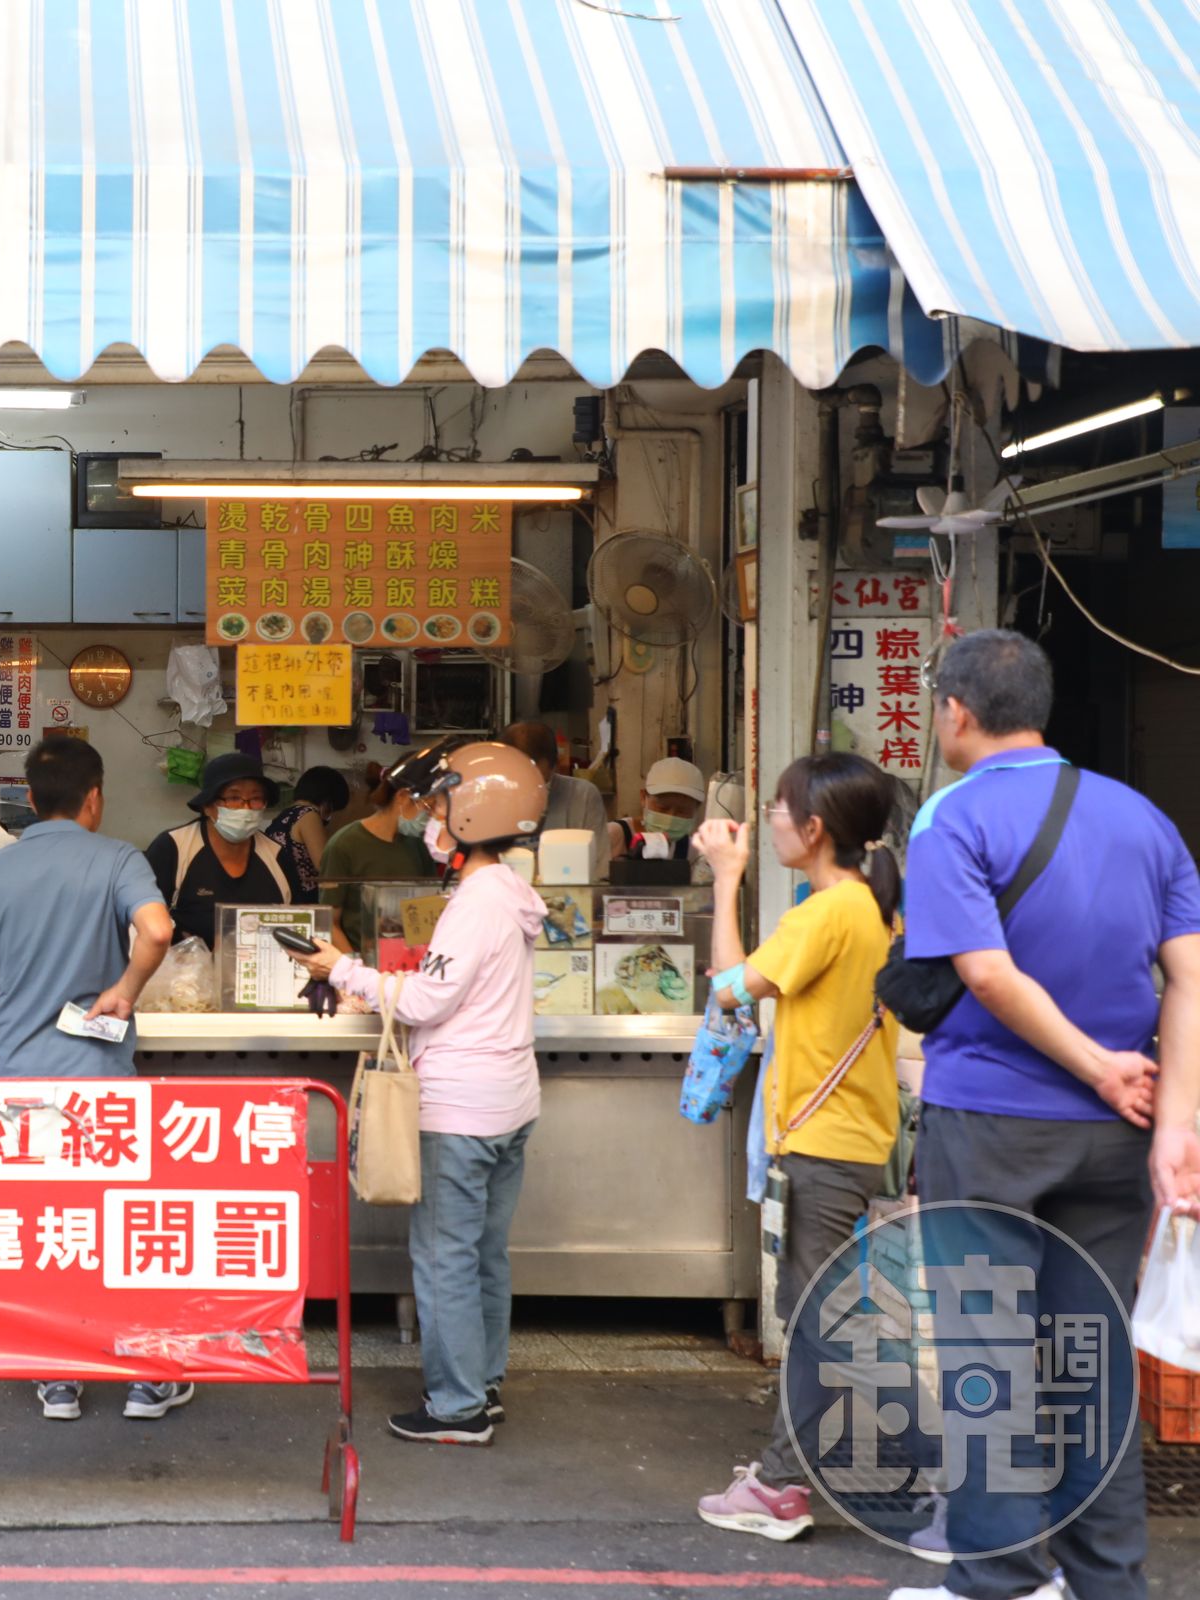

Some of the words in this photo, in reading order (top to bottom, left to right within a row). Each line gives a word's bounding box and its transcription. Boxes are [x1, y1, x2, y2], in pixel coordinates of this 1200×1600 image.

[218, 502, 248, 607] 燙青菜
[260, 502, 290, 607] 乾骨肉
[303, 503, 331, 607] 骨肉湯
[344, 503, 373, 607] 四神湯
[386, 503, 416, 607] 魚酥飯
[428, 503, 457, 607] 肉燥飯
[471, 504, 500, 607] 米糕
[17, 734, 31, 746] 90
[875, 628, 921, 768] 粽葉米糕
